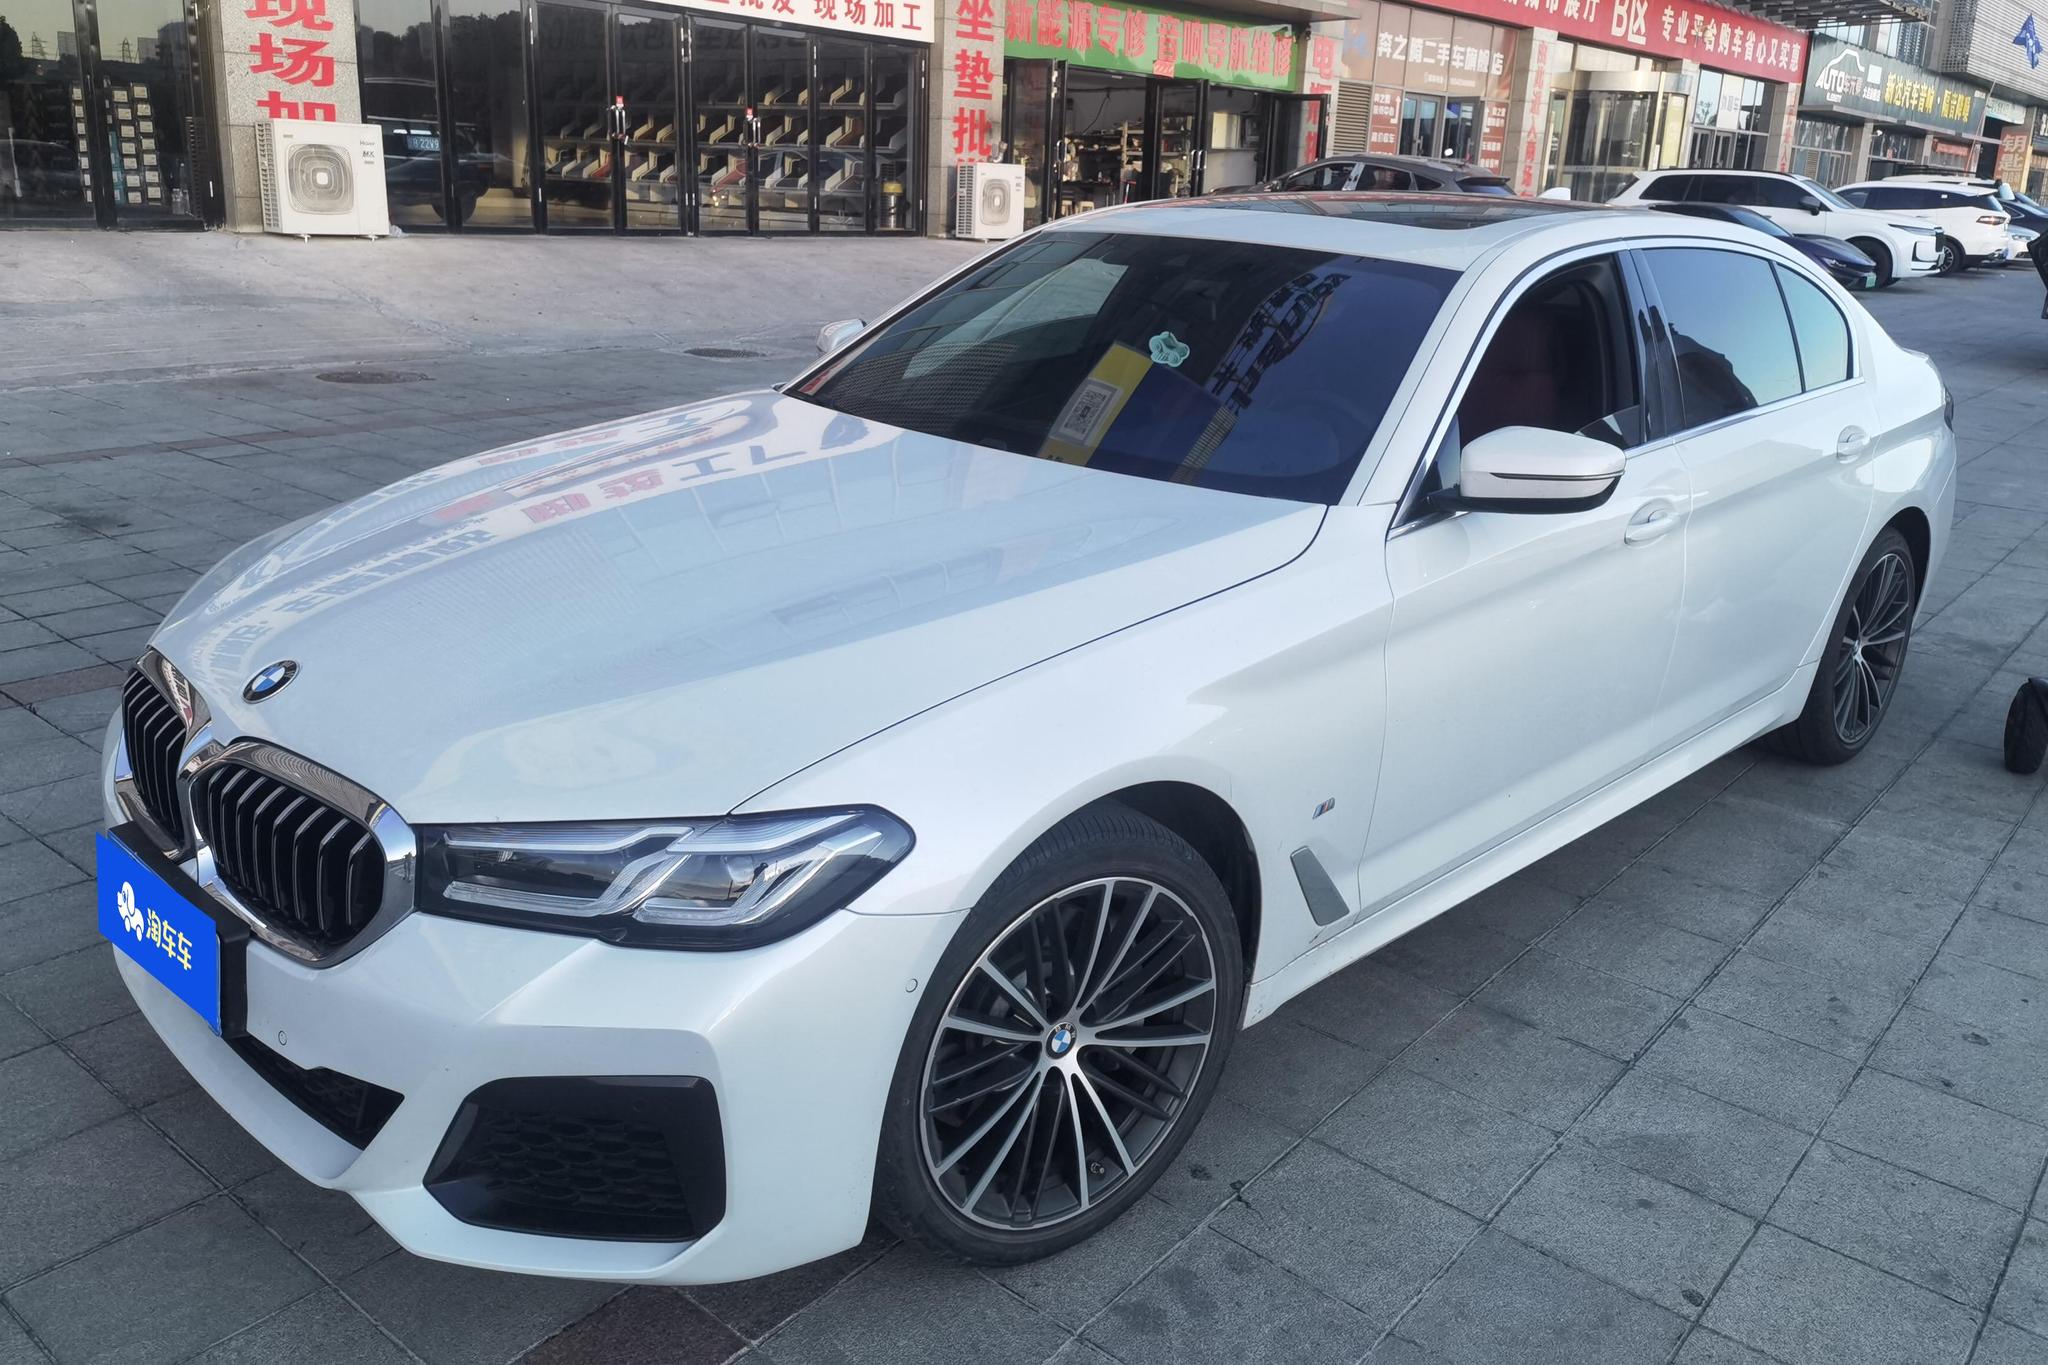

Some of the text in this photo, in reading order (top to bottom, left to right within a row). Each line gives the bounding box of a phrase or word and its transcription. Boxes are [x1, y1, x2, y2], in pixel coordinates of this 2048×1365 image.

[952, 0, 995, 163] 坐垫批
[1814, 67, 1846, 93] AUTO
